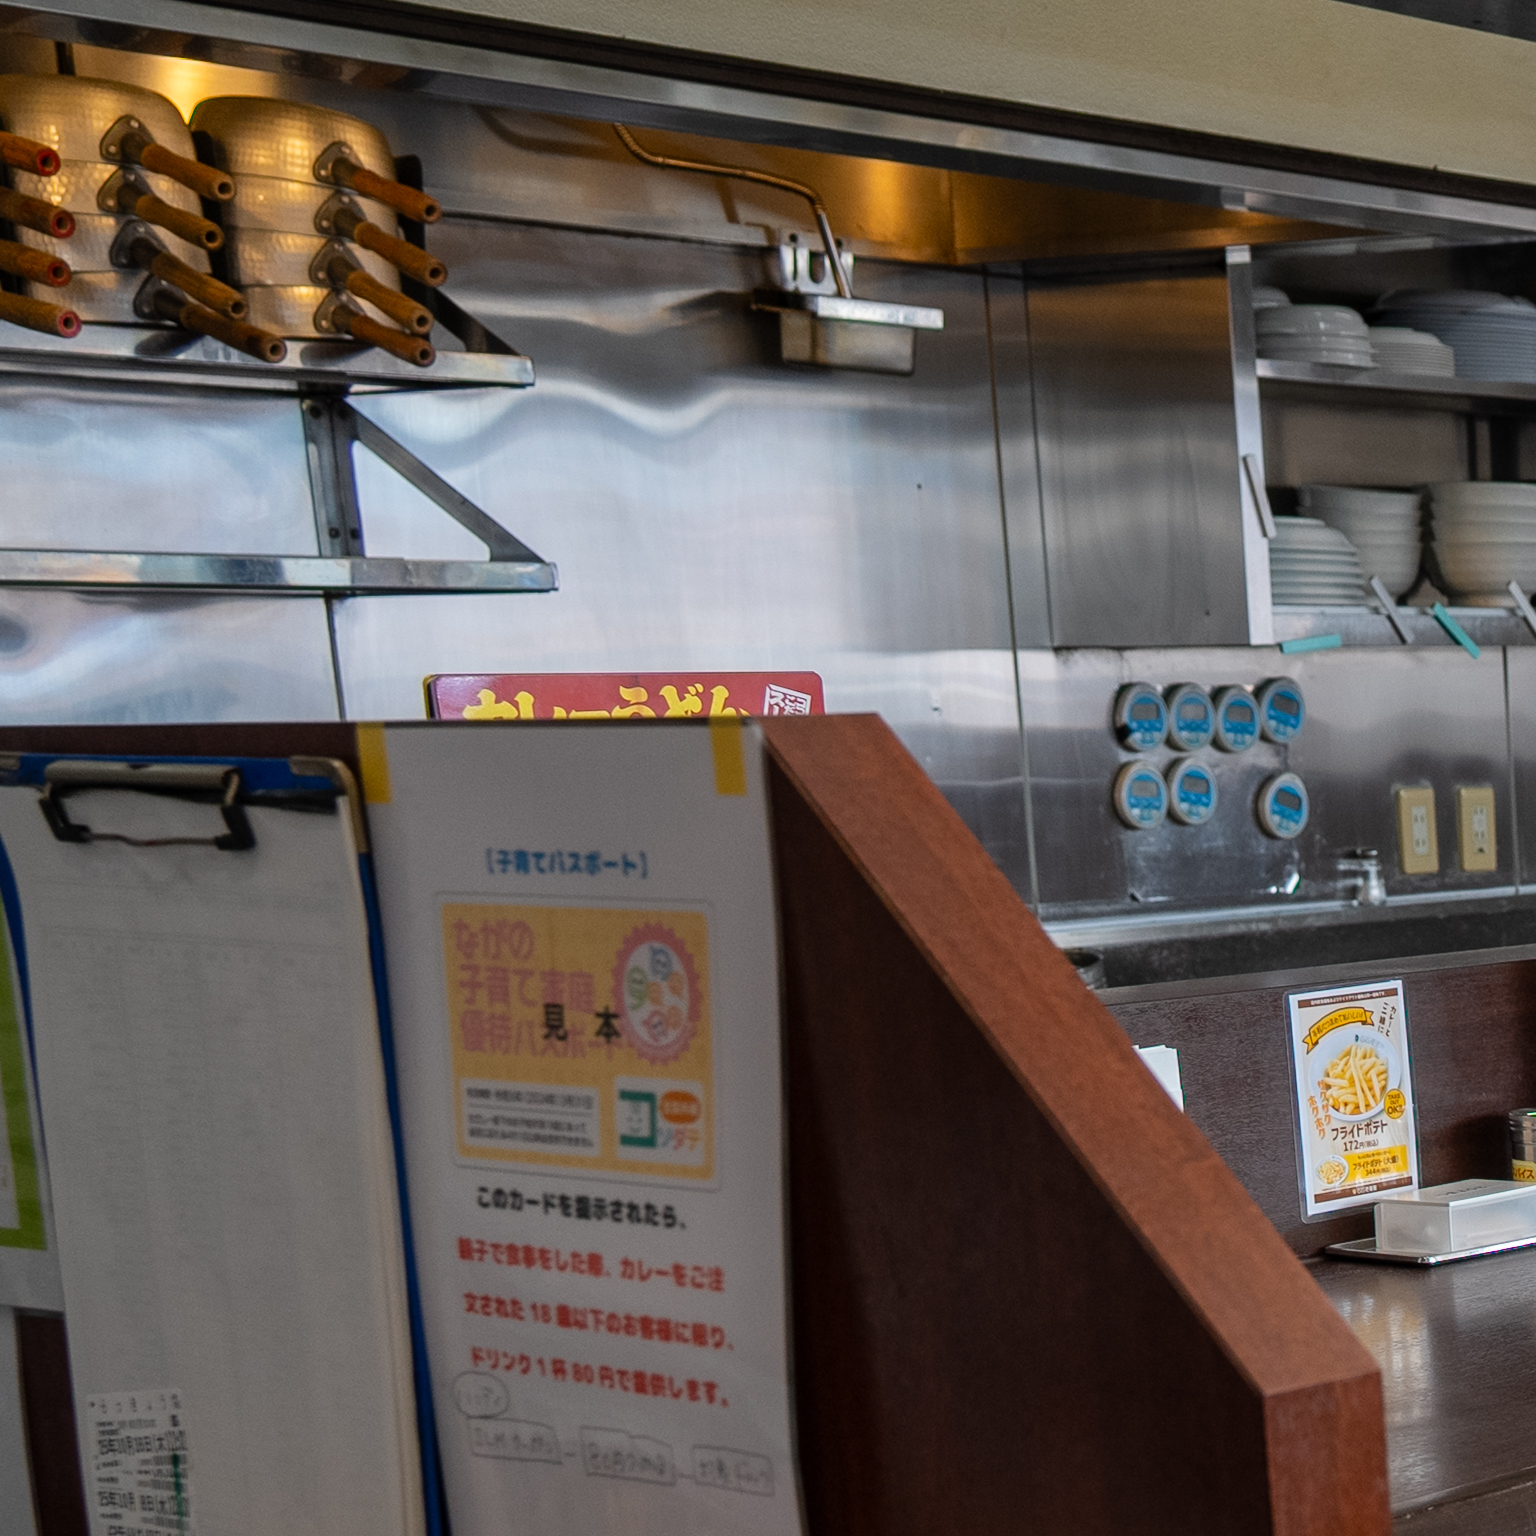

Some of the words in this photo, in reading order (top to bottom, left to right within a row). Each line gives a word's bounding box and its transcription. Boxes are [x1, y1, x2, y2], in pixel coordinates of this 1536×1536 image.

[454, 918, 535, 960] ながの
[1331, 1119, 1388, 1141] フライドポテト
